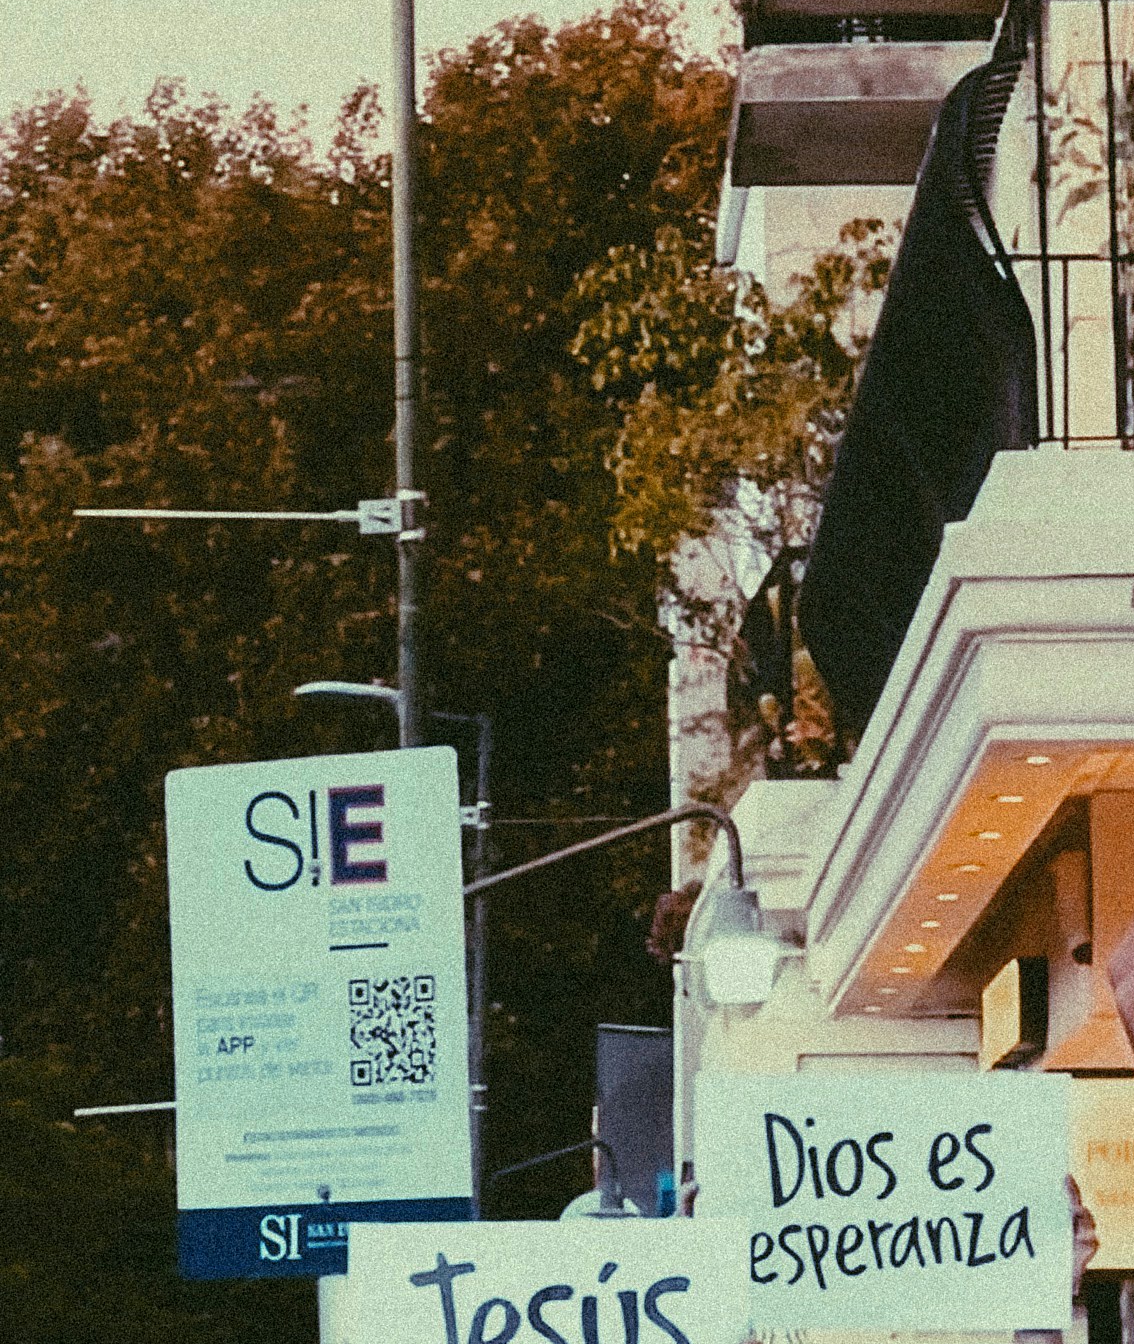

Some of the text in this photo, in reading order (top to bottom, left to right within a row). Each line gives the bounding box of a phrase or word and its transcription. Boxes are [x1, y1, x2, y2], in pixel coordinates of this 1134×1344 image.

[216, 1035, 255, 1055] APP
[764, 1112, 996, 1208] Dios es
[259, 1213, 302, 1261] SI
[749, 1206, 1036, 1290] esperanza
